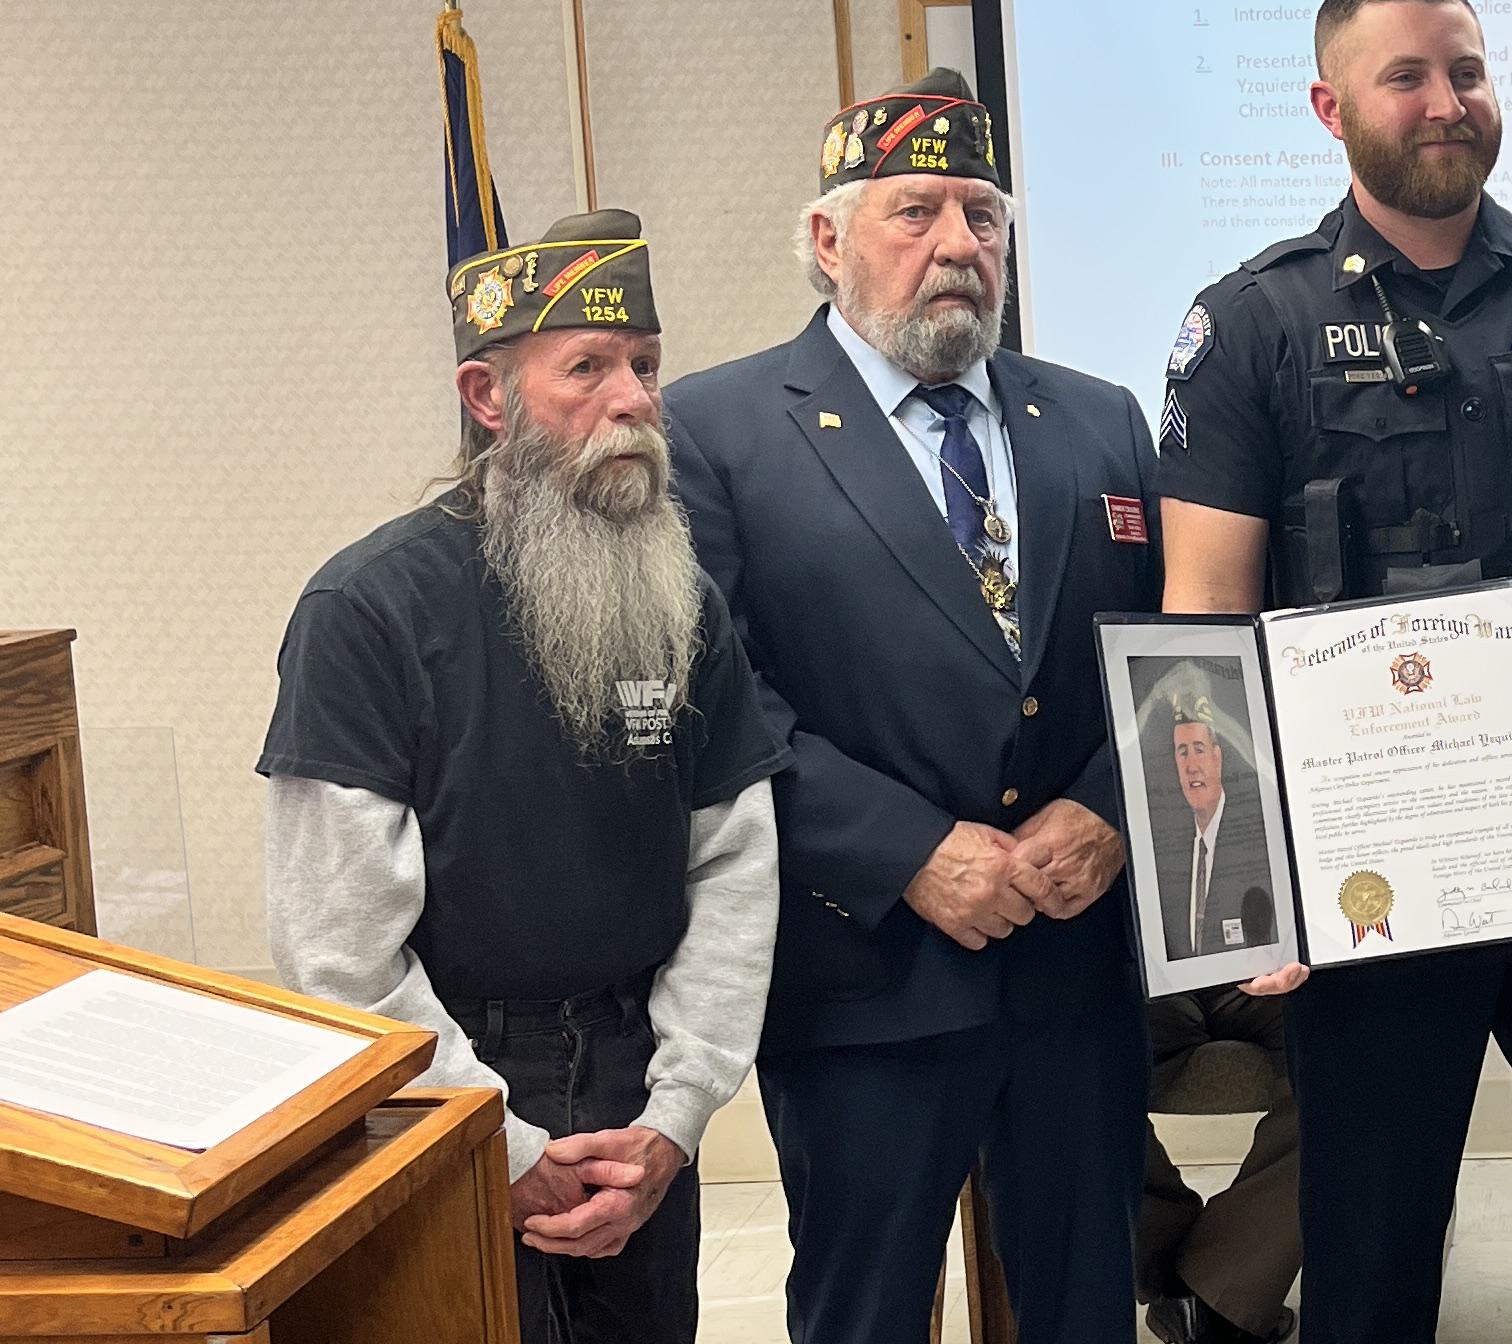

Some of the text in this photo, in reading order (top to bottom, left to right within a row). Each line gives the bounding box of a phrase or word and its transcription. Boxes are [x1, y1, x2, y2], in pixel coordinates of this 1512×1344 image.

[1194, 8, 1210, 26] 1.
[1233, 5, 1312, 23] Introduce
[1195, 55, 1213, 74] 2.
[1236, 54, 1313, 70] Presentat
[1488, 45, 1509, 62] nd
[1238, 102, 1309, 119] Christian
[911, 137, 947, 154] VFW
[909, 153, 949, 170] 1254
[1161, 149, 1343, 168] III. Consent Agenda
[1200, 176, 1237, 189] Note:
[1240, 175, 1257, 188] All
[1260, 176, 1312, 188] matters
[1315, 174, 1350, 187] listed
[1201, 196, 1240, 208] There
[1243, 195, 1286, 208] should
[1289, 195, 1306, 206] be
[1310, 196, 1326, 206] no
[1201, 216, 1227, 229] and
[1230, 215, 1261, 227] then
[1264, 214, 1318, 227] consider
[580, 288, 624, 304] VFW
[582, 306, 630, 323] 1254
[1325, 324, 1382, 358] POLI
[1280, 630, 1367, 677] Veterans
[1370, 617, 1387, 640] of
[1391, 613, 1470, 640] Foreign
[1389, 699, 1448, 716] National
[1451, 693, 1483, 707] Law
[1349, 710, 1481, 737] Enforcement Award
[1301, 755, 1343, 769] Master
[1345, 746, 1384, 765] Patrol
[1387, 743, 1426, 758] Officer
[1430, 737, 1475, 753] Michael
